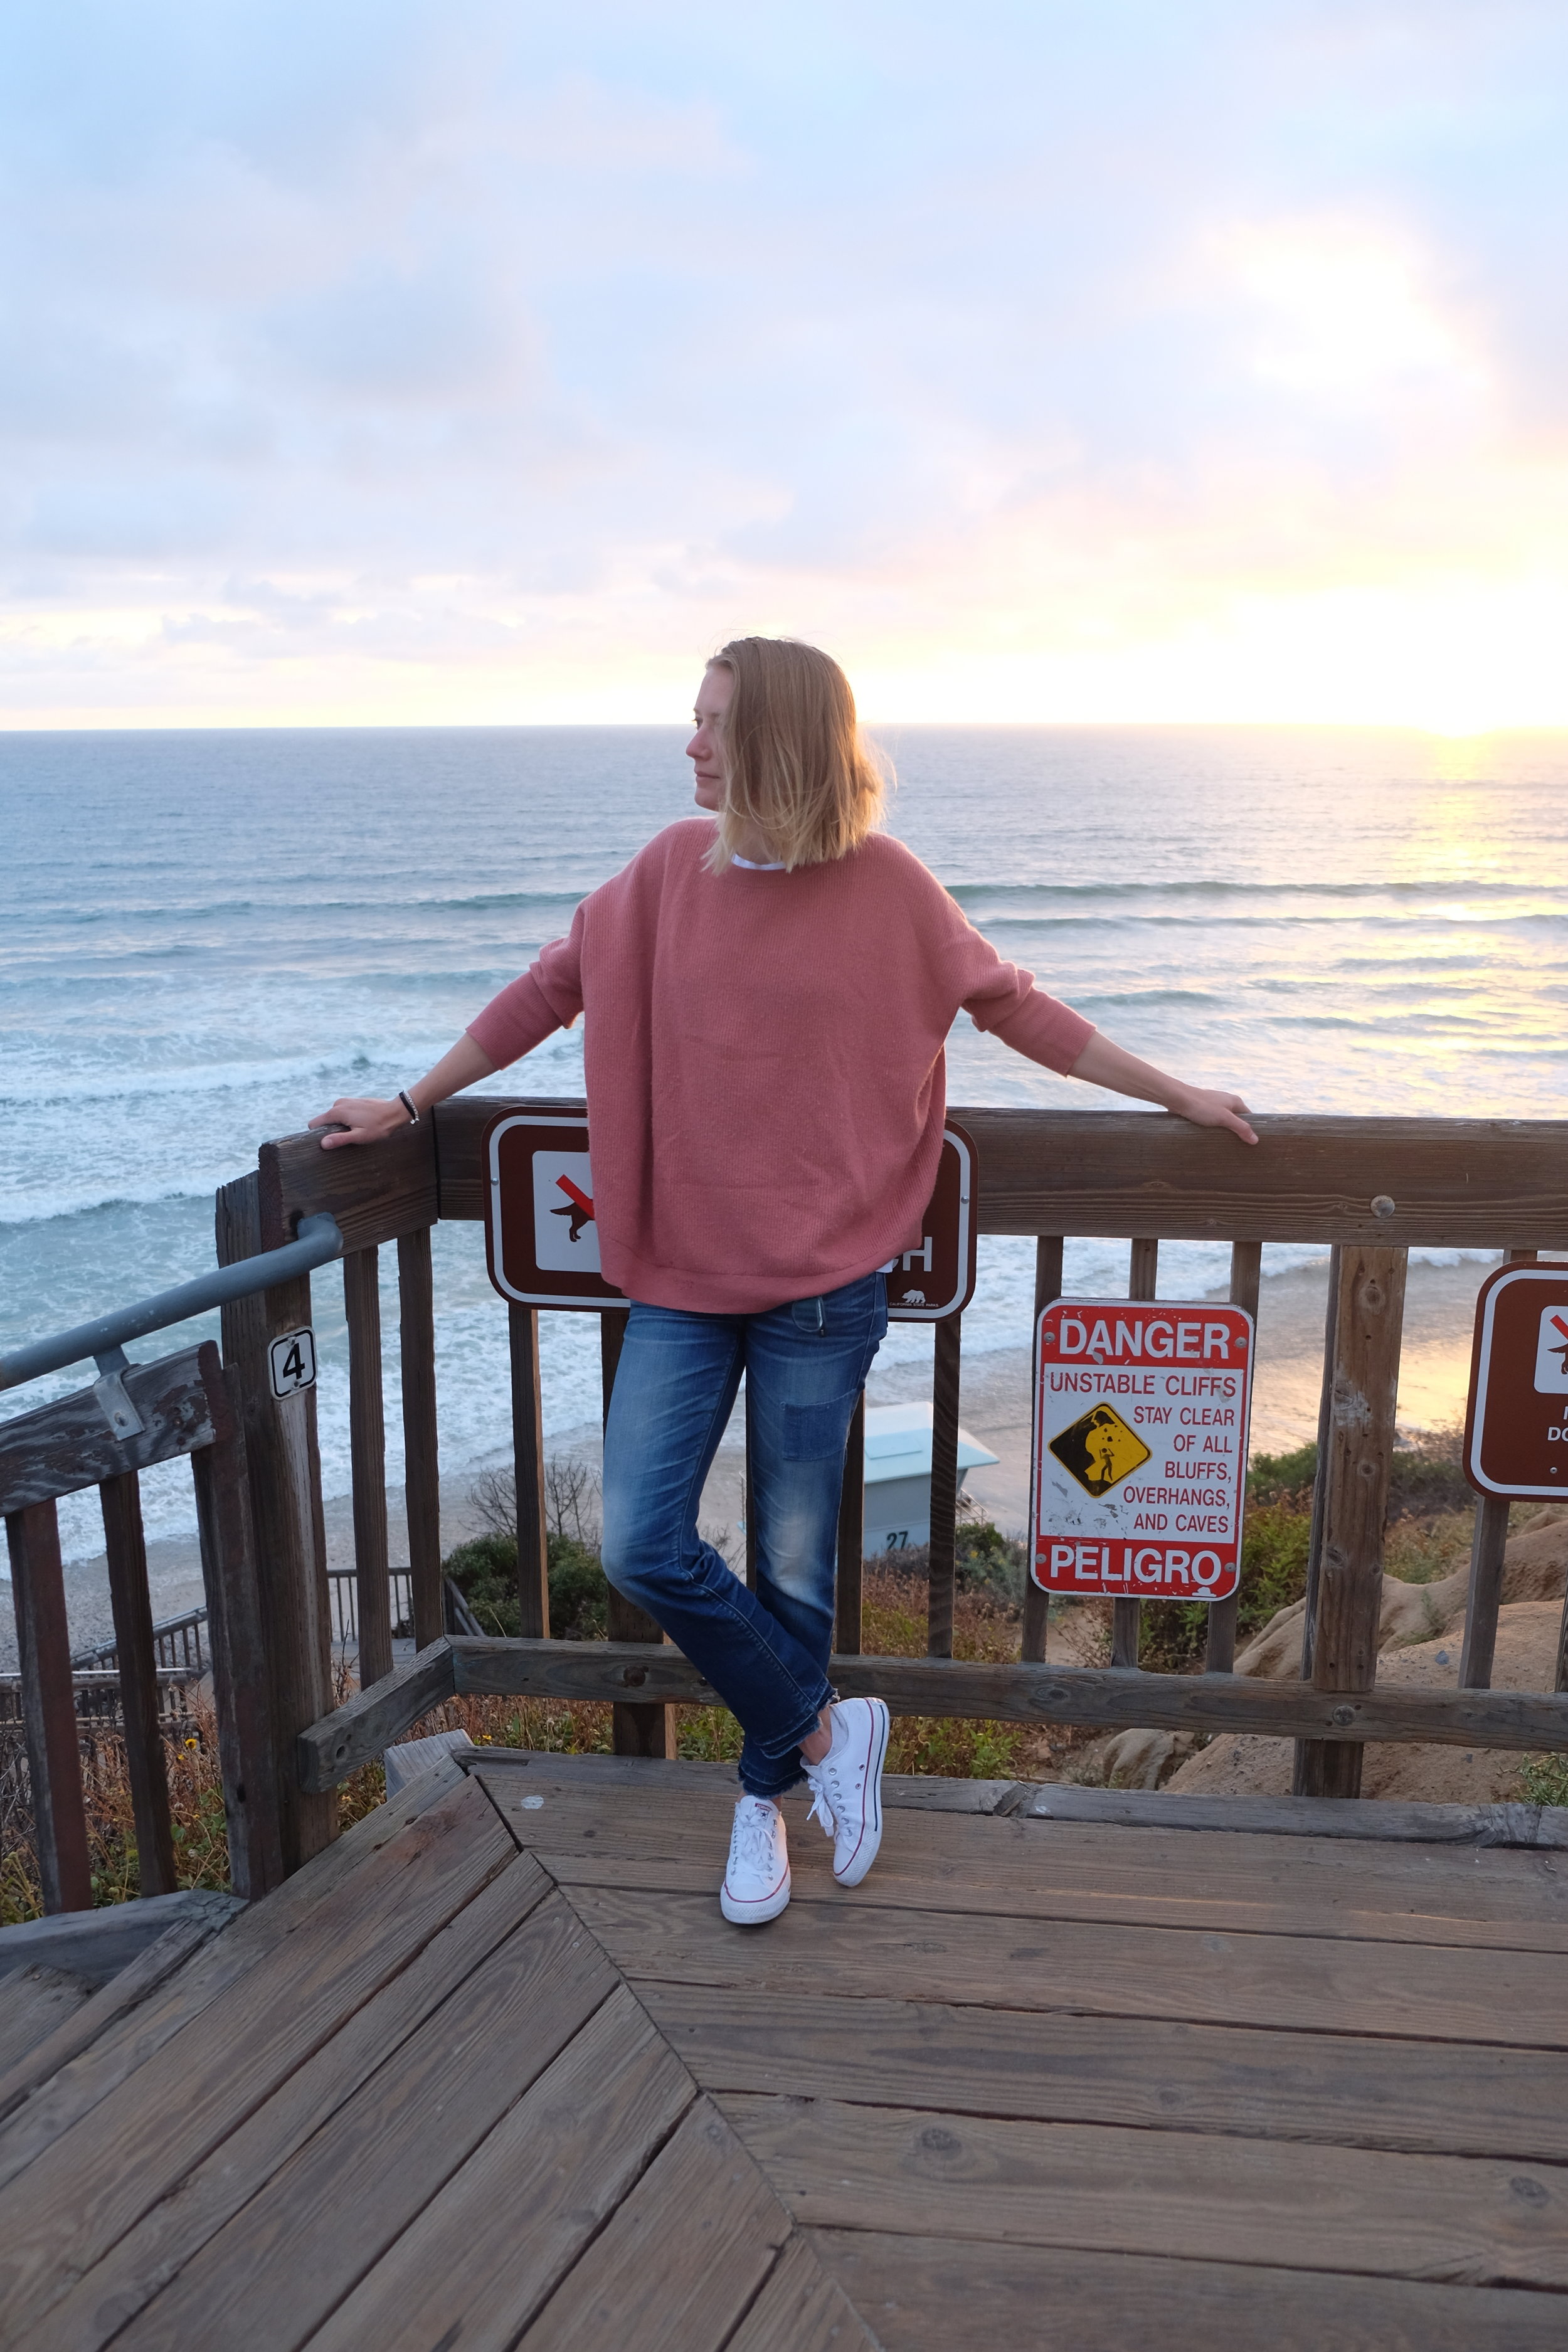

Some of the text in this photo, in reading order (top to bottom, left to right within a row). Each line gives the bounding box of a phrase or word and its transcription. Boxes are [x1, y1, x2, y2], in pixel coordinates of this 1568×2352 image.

[1059, 1318, 1230, 1359] DANGER
[283, 1343, 305, 1380] 4
[1050, 1372, 1236, 1397] UNSTABLE CLIFFS
[1133, 1406, 1234, 1426] STAY CLEAR
[1173, 1434, 1232, 1453] OF ALL
[1165, 1461, 1232, 1483] BLUFFS,
[1123, 1486, 1230, 1510] OVERHANGS,
[1133, 1513, 1229, 1534] AND CAVES
[886, 1530, 909, 1550] 27
[1051, 1544, 1221, 1586] PELIGRO
